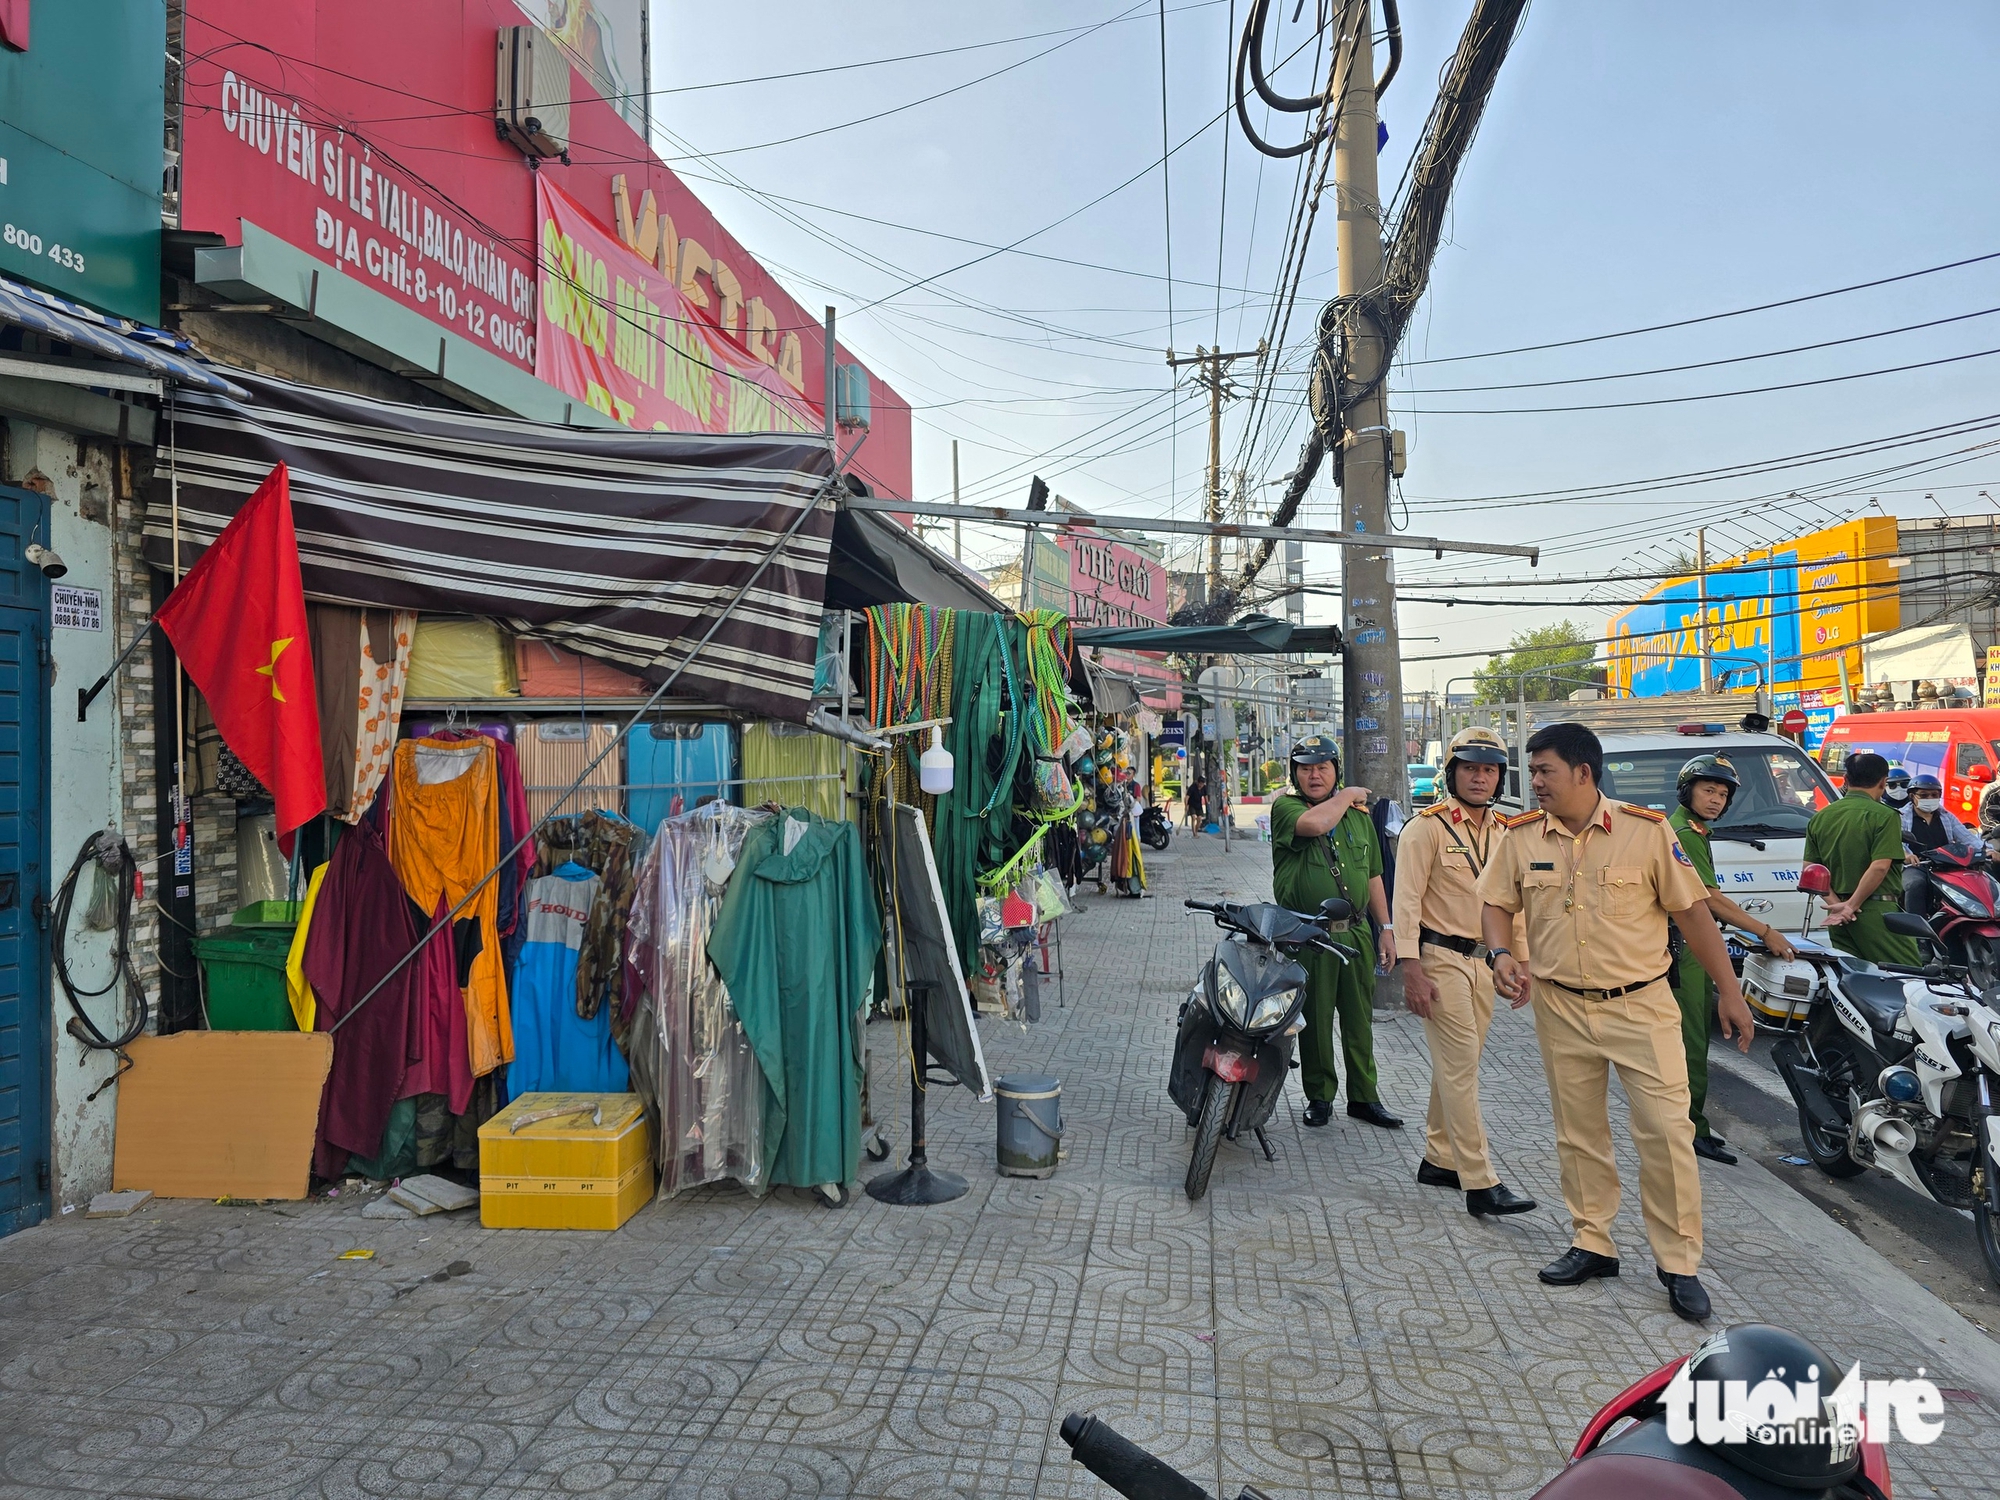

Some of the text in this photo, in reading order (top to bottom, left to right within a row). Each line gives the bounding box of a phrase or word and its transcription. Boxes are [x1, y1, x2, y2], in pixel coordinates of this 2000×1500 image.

[222, 70, 316, 186] CHUYÊN
[3, 223, 85, 273] 800 433
[315, 207, 361, 271] ĐỊA
[365, 238, 411, 296] CHỈ:
[490, 313, 536, 367] QUỐC
[543, 218, 608, 358] SANG
[613, 275, 660, 399] MẶT
[1075, 538, 1115, 586] THẾ
[1118, 557, 1151, 601] GIỚI
[1812, 573, 1839, 590] AQUA
[1677, 597, 1769, 660] XANH
[1827, 626, 1840, 640] LG
[1734, 871, 1754, 882] SÁT
[1772, 869, 1800, 883] TRẬT
[1836, 1001, 1867, 1034] POLICE
[1916, 1048, 1949, 1072] CSGT
